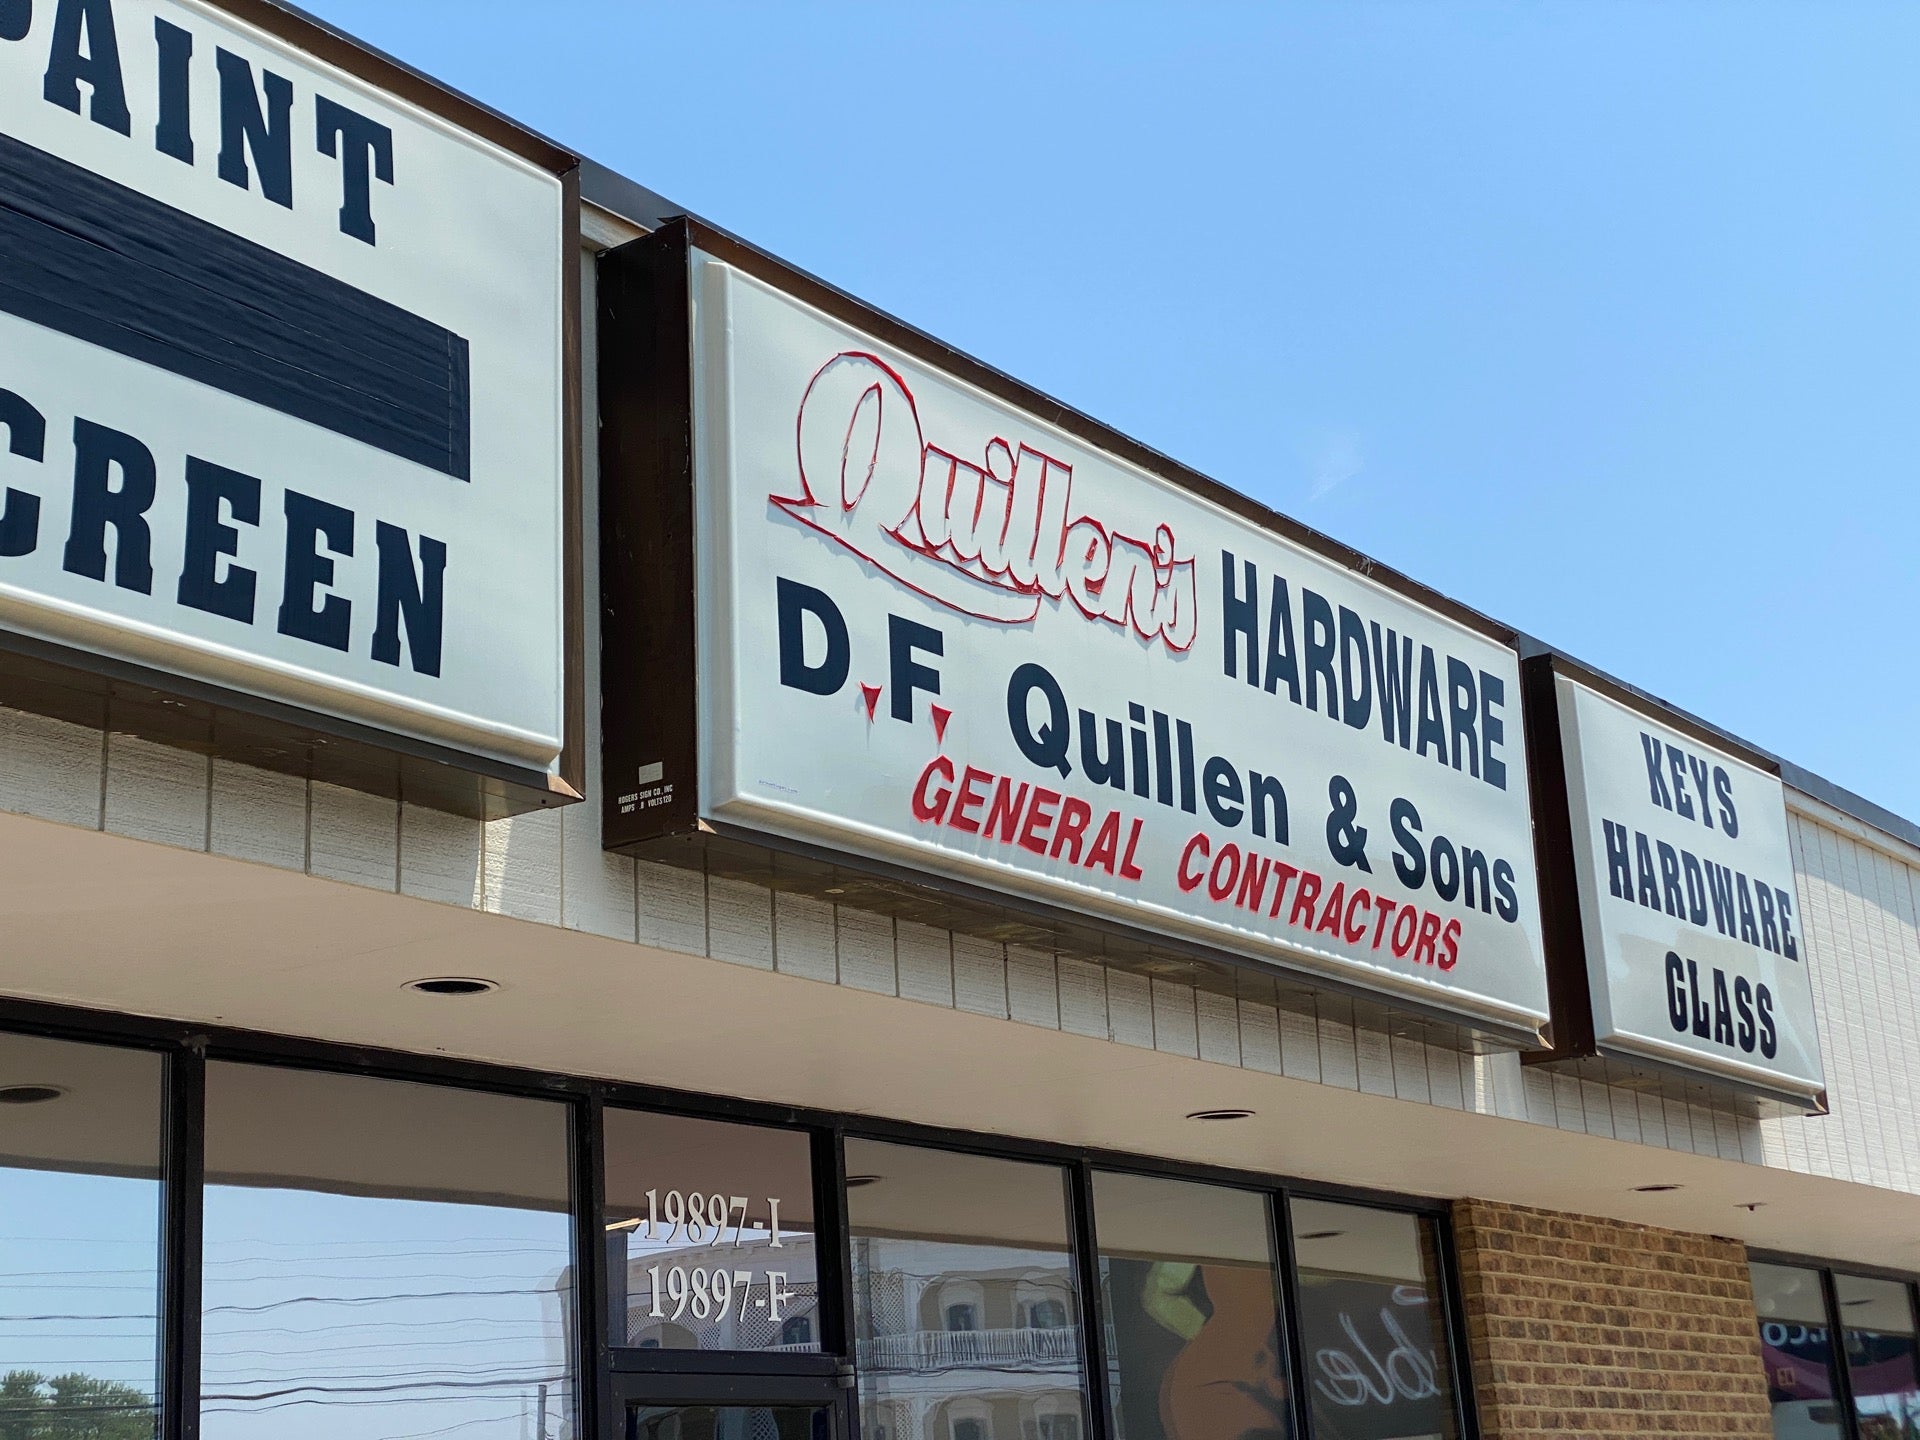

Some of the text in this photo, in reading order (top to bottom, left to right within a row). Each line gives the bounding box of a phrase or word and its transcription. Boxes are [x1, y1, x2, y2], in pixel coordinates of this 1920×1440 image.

[0, 0, 394, 247] AINT
[1221, 549, 1507, 791] HARDWARE
[621, 804, 635, 814] AMPS
[640, 789, 652, 799] SIGN
[1006, 662, 1290, 847] Quillen
[1326, 775, 1374, 874] &
[1389, 796, 1520, 923] Sons
[1639, 731, 1738, 840] KEYS
[911, 755, 1463, 972] GENERAL CONTRACTORS
[1602, 818, 1800, 962] HARDWARE
[1664, 950, 1777, 1060] GLASS
[644, 1188, 783, 1249] 19897-I
[647, 1265, 788, 1323] 19897-F
